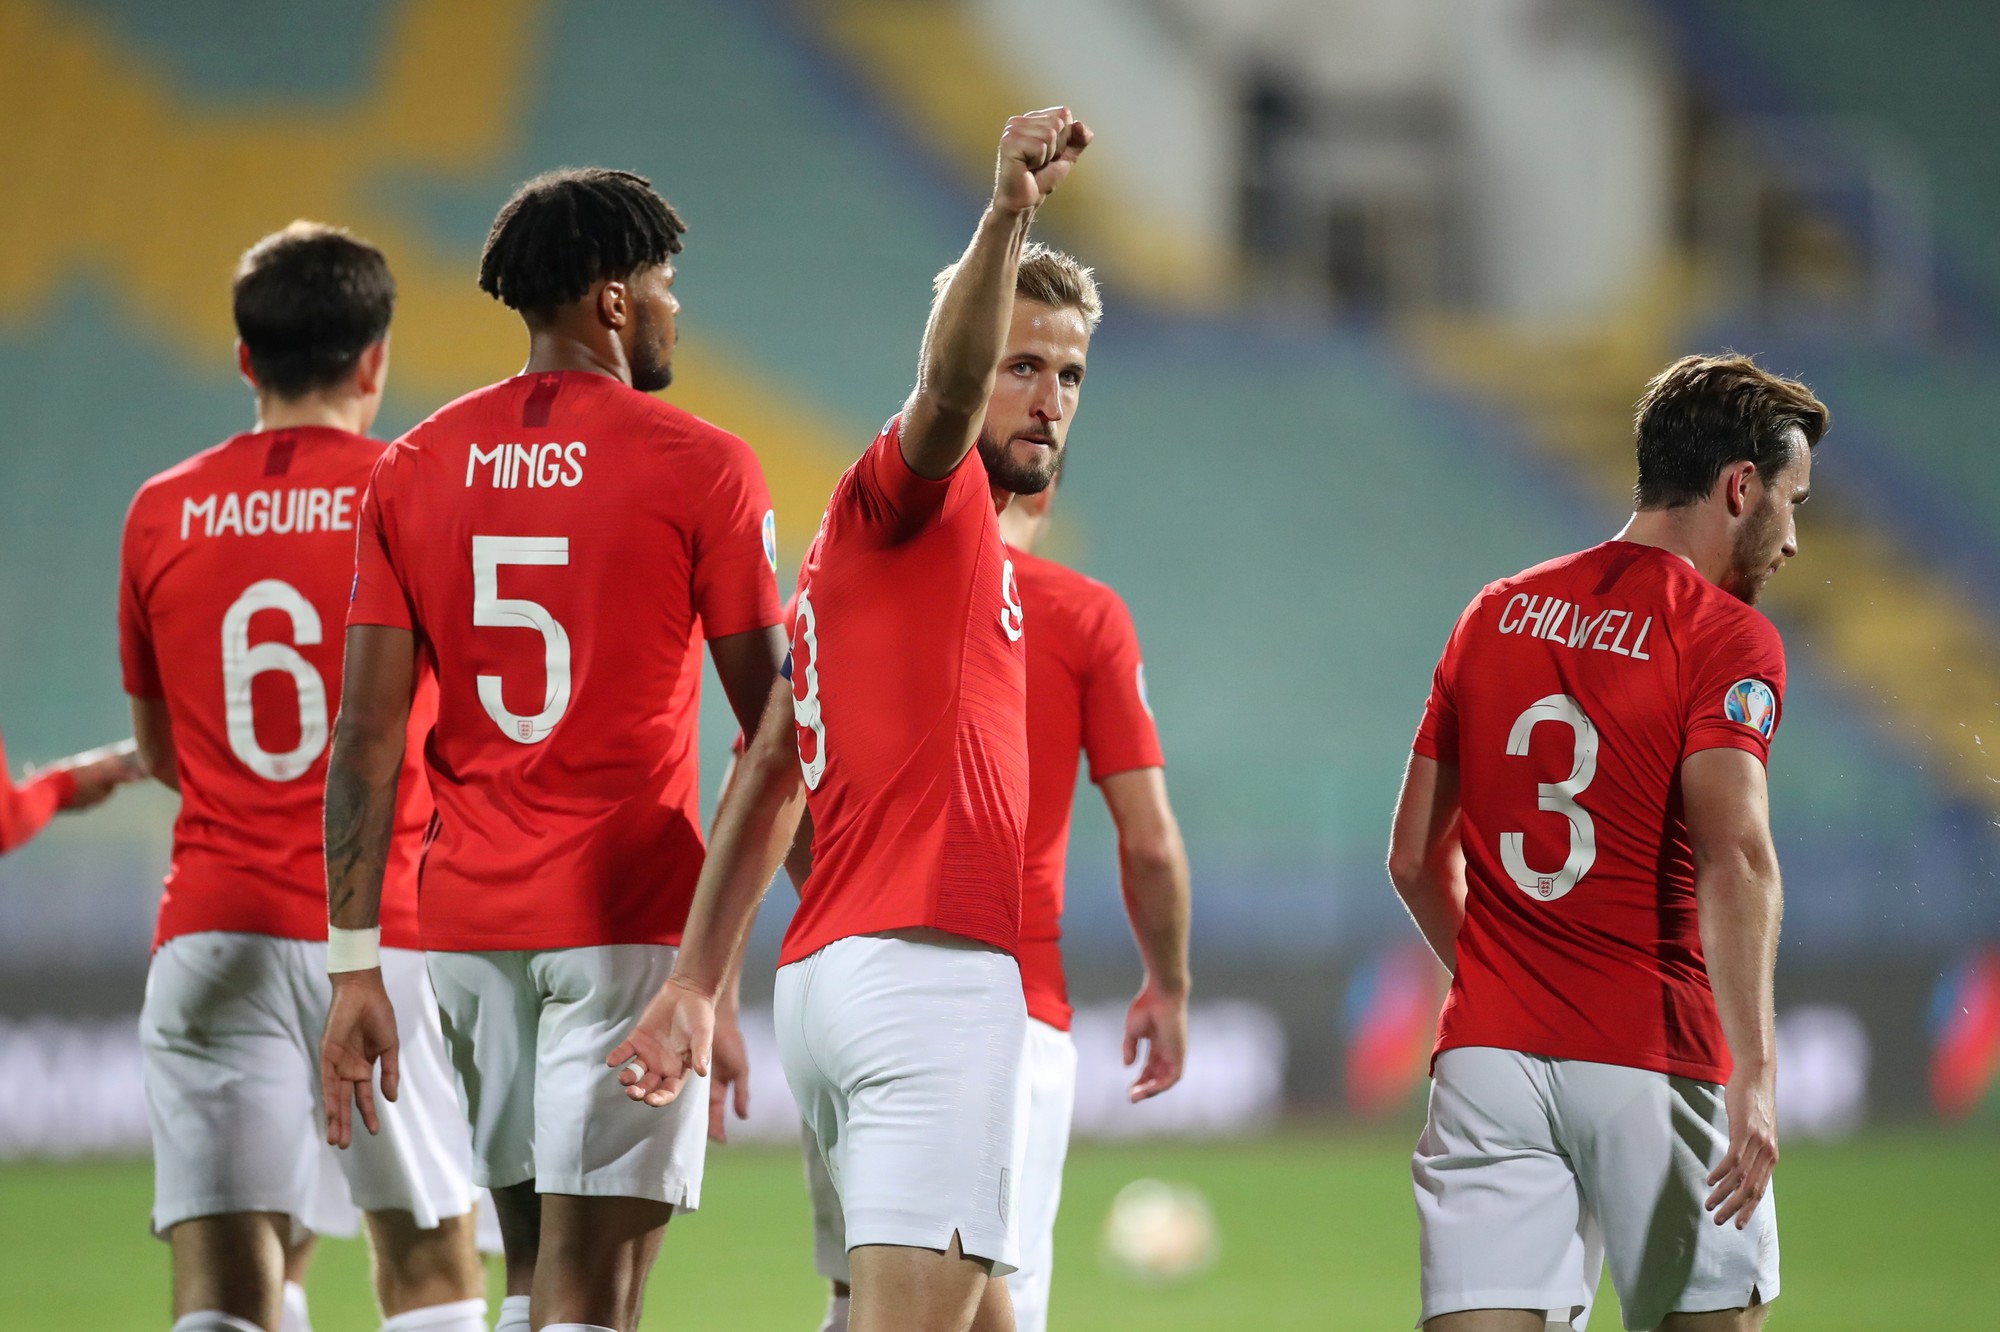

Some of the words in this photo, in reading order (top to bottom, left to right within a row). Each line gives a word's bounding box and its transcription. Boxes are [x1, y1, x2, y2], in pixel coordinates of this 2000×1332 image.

[465, 441, 587, 489] MINGS
[180, 485, 357, 541] MAGUIRE
[472, 535, 572, 745] 5
[1000, 559, 1024, 642] 9
[1497, 592, 1654, 661] CHILWELL
[222, 579, 329, 782] 6
[1499, 693, 1600, 902] 3
